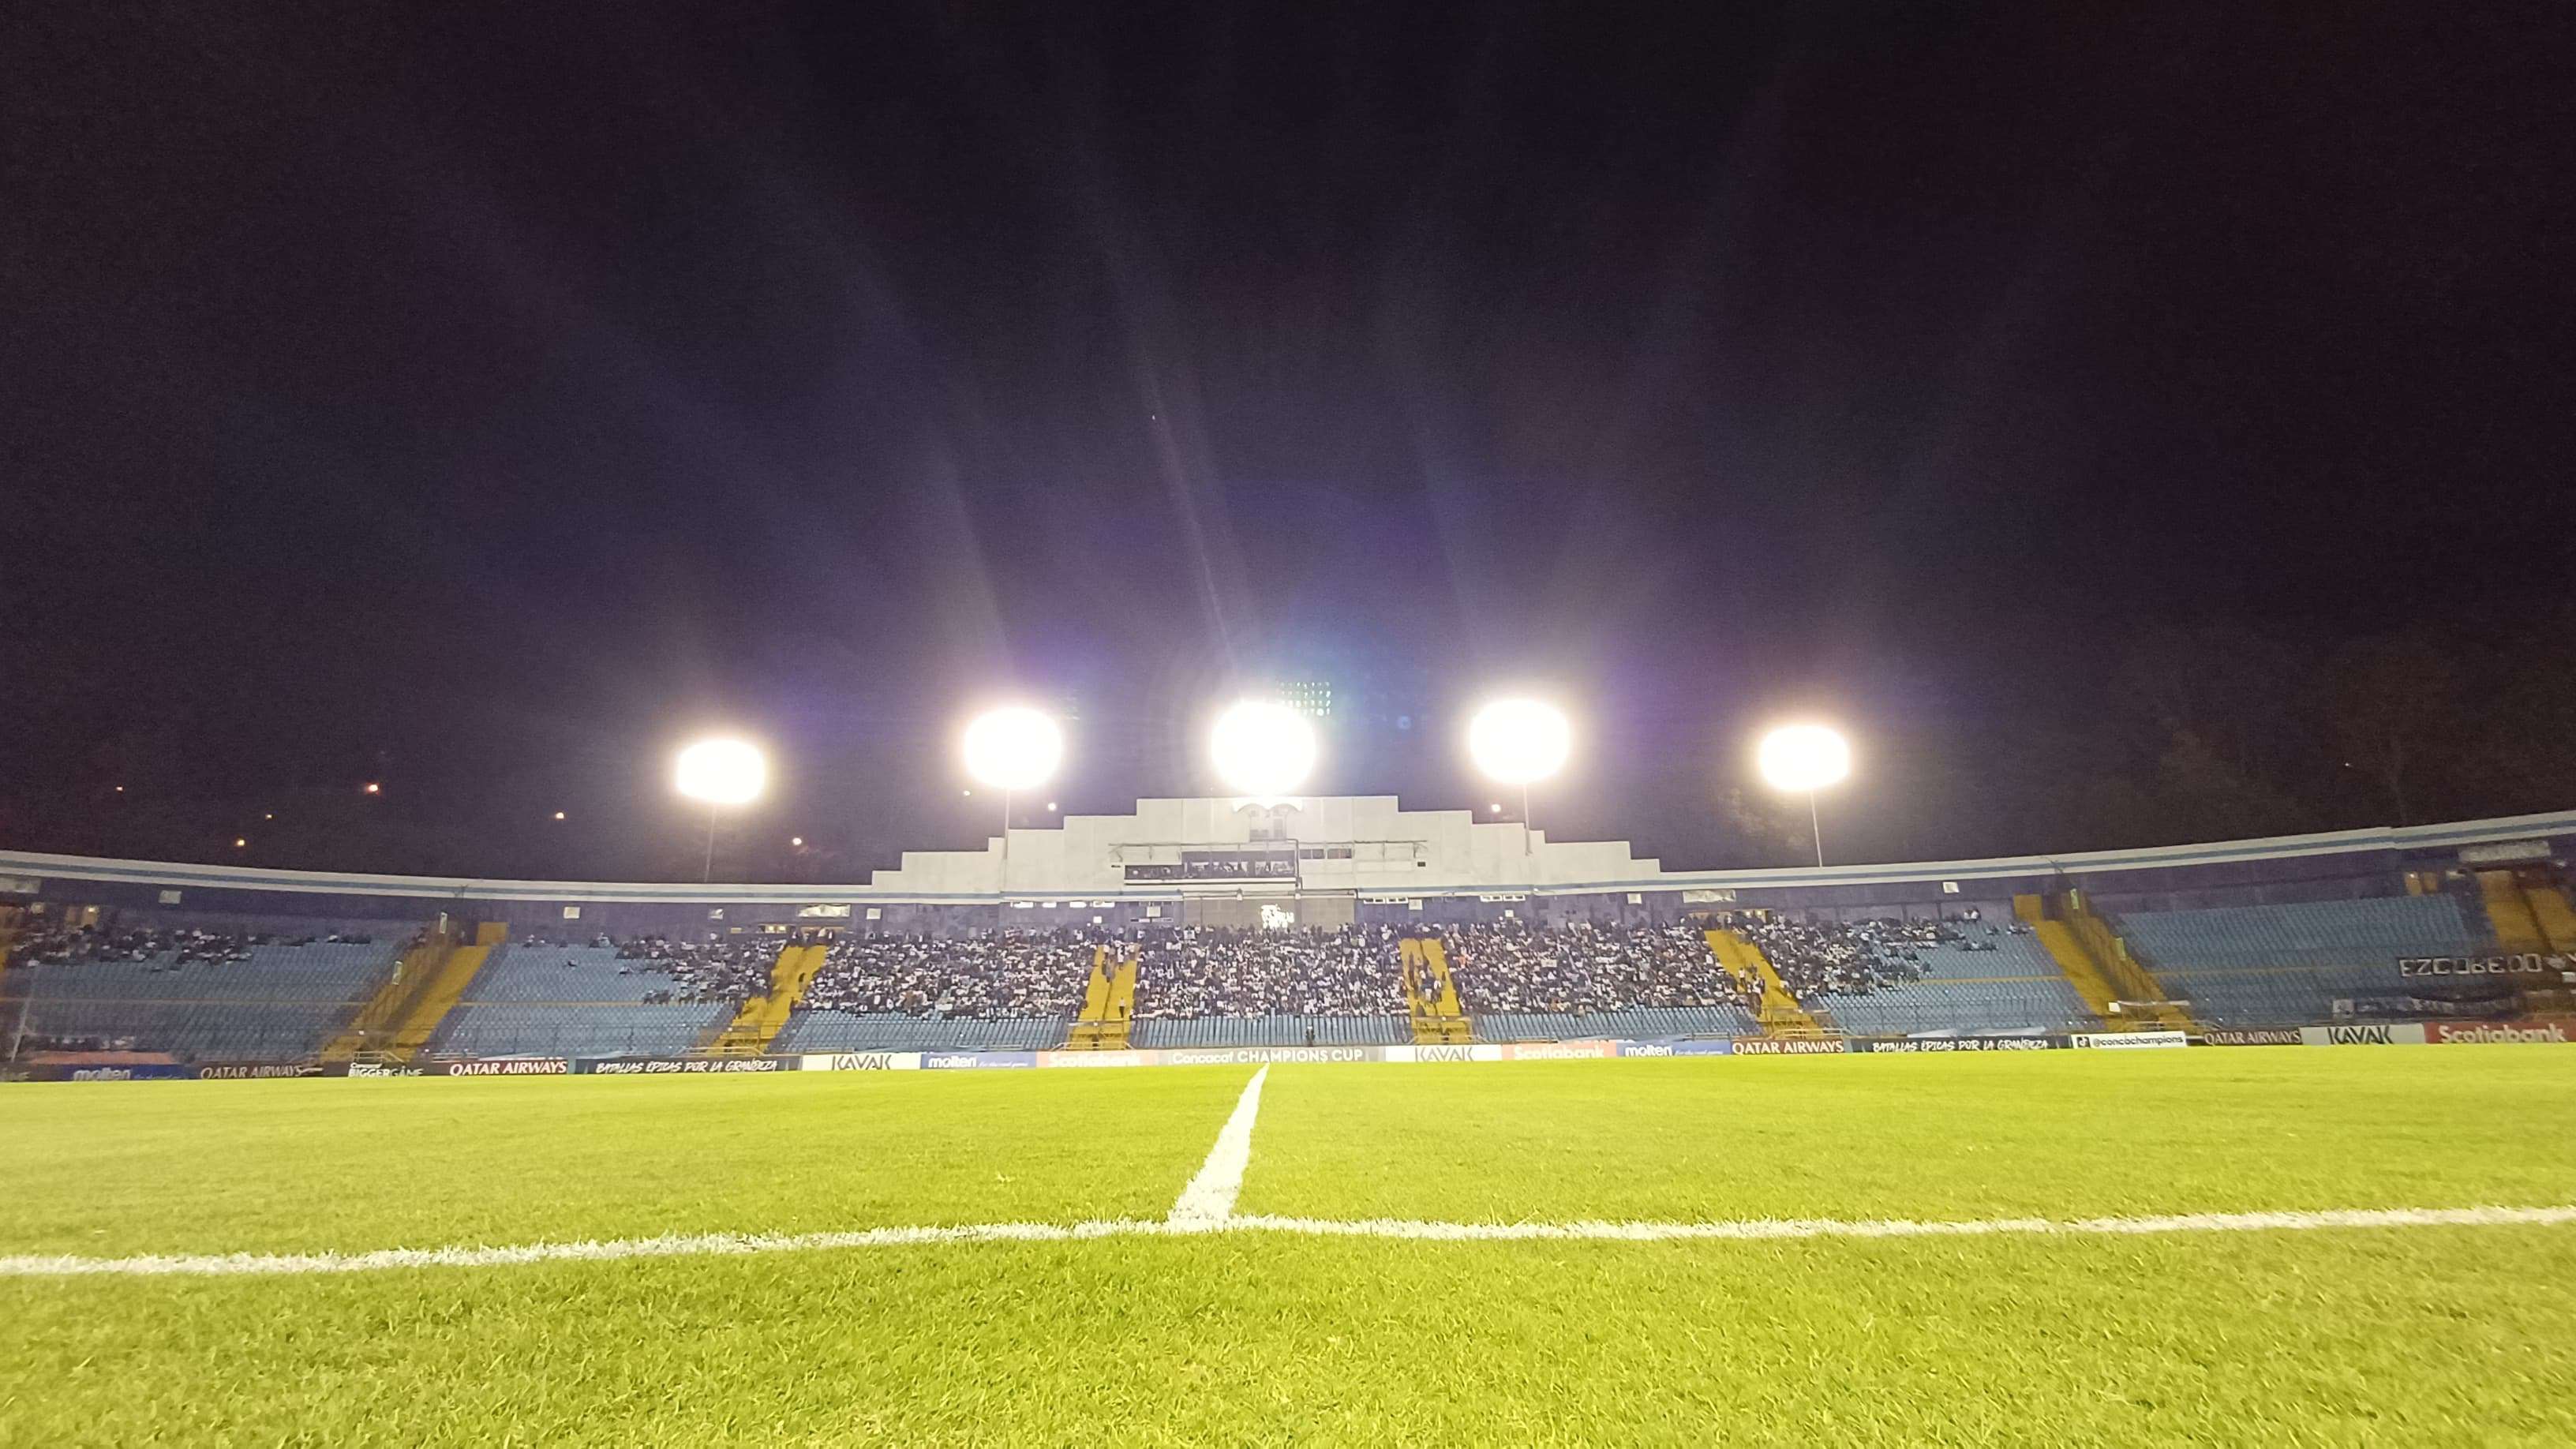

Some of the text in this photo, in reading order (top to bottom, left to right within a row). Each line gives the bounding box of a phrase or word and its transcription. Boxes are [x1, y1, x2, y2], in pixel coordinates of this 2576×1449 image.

[2203, 1030, 2301, 1046] QATAR AIRWAYS
[2327, 1025, 2393, 1044] KAVAK
[2439, 1024, 2566, 1043] Scotiabank
[1514, 1045, 1604, 1060] Scotiabank
[1625, 1044, 1673, 1057] molten
[1732, 1042, 1780, 1055] QATAR
[1783, 1039, 1844, 1054] AIRWAYS
[1872, 1042, 1918, 1053] BATALLAS
[1958, 1039, 1981, 1051] POR
[1983, 1040, 1994, 1050] LA
[1173, 1047, 1364, 1064] Concacaf CHAMPIONS CUP
[1415, 1046, 1474, 1062] KAVAK
[449, 1061, 567, 1076] QATAR AIRWAYS
[683, 1061, 709, 1073] POR
[710, 1061, 724, 1073] LA
[831, 1054, 892, 1070] KAVAK
[928, 1056, 977, 1068] molten
[73, 1067, 131, 1080] molten
[200, 1067, 246, 1080] QATAR
[249, 1065, 302, 1078] AIRWAYS
